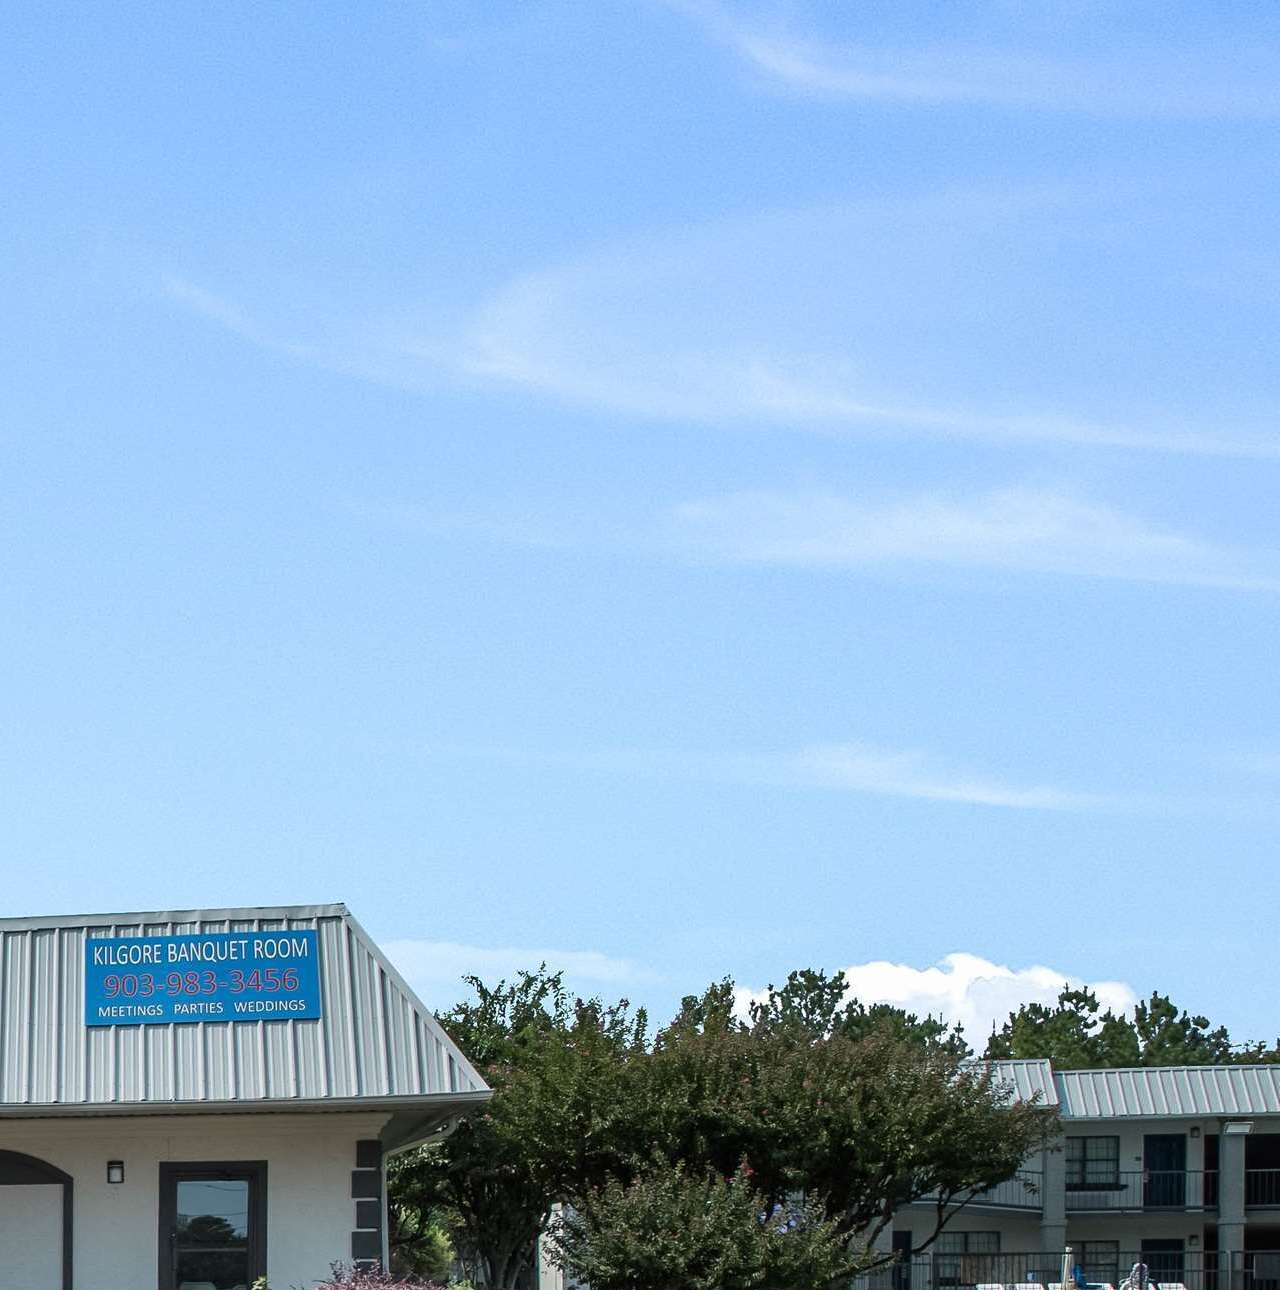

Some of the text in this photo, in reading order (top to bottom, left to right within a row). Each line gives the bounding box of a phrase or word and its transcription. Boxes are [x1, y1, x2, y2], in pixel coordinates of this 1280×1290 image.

[94, 937, 308, 965] KILGORE BANQUET ROOM
[103, 968, 299, 998] 903-983-3456
[98, 999, 306, 1017] MEETINGS PARTIES WEDDINGS
